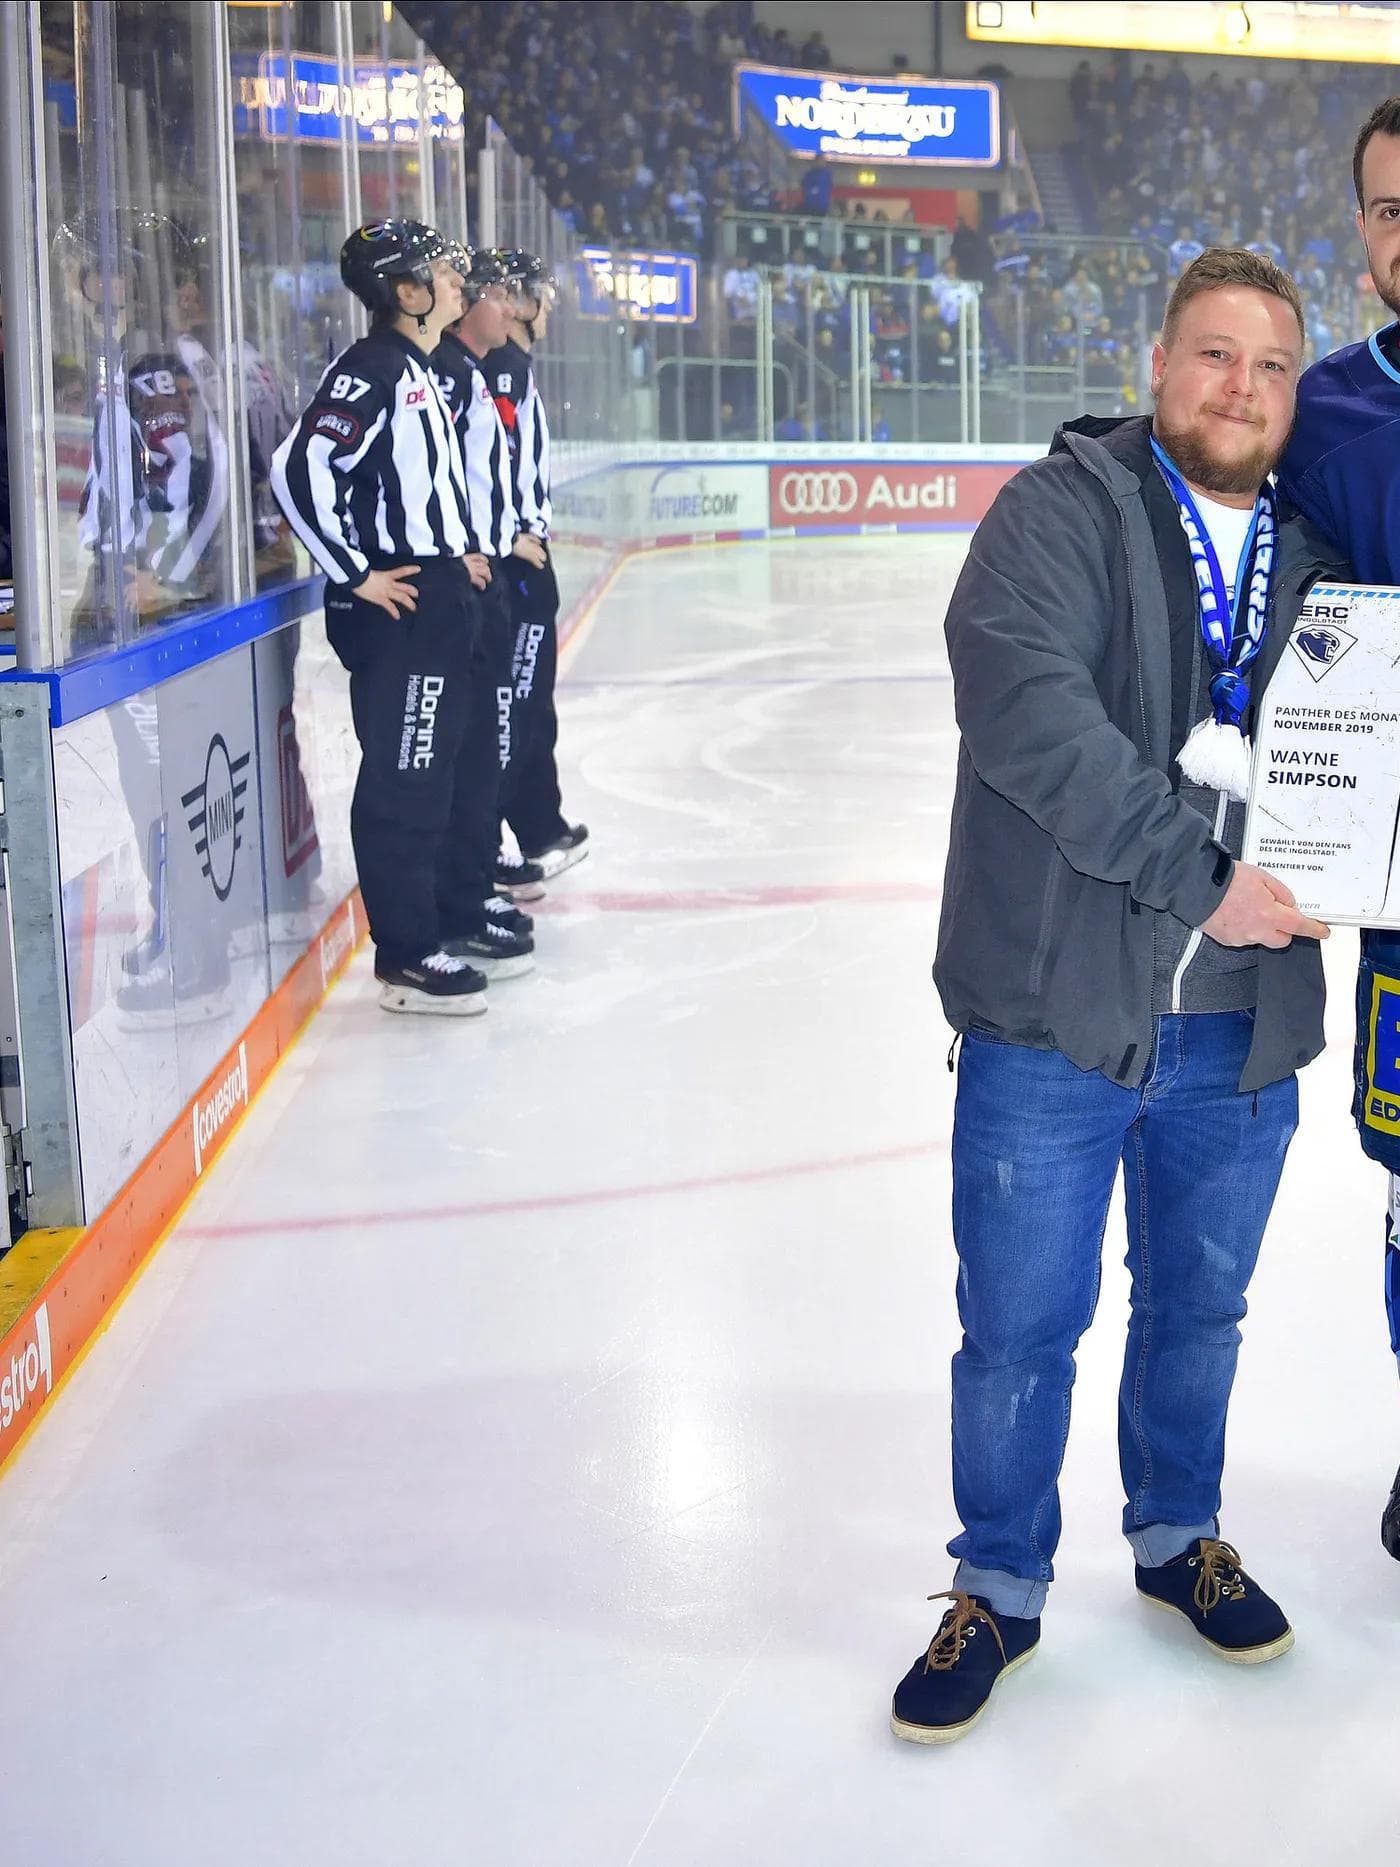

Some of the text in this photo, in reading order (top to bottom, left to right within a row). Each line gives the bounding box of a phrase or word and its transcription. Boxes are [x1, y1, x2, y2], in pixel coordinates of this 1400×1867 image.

[330, 374, 371, 402] 97
[865, 475, 957, 508] Audi
[1298, 605, 1348, 619] ERC
[516, 623, 545, 699] Dorint
[413, 675, 445, 769] Dorint
[1275, 706, 1331, 719] PANTHER
[1334, 710, 1356, 720] DES
[1274, 720, 1374, 734] NOVEMBER 2019
[1270, 749, 1340, 767] WAYNE
[1267, 770, 1358, 789] SIMPSON
[208, 790, 233, 845] MINI
